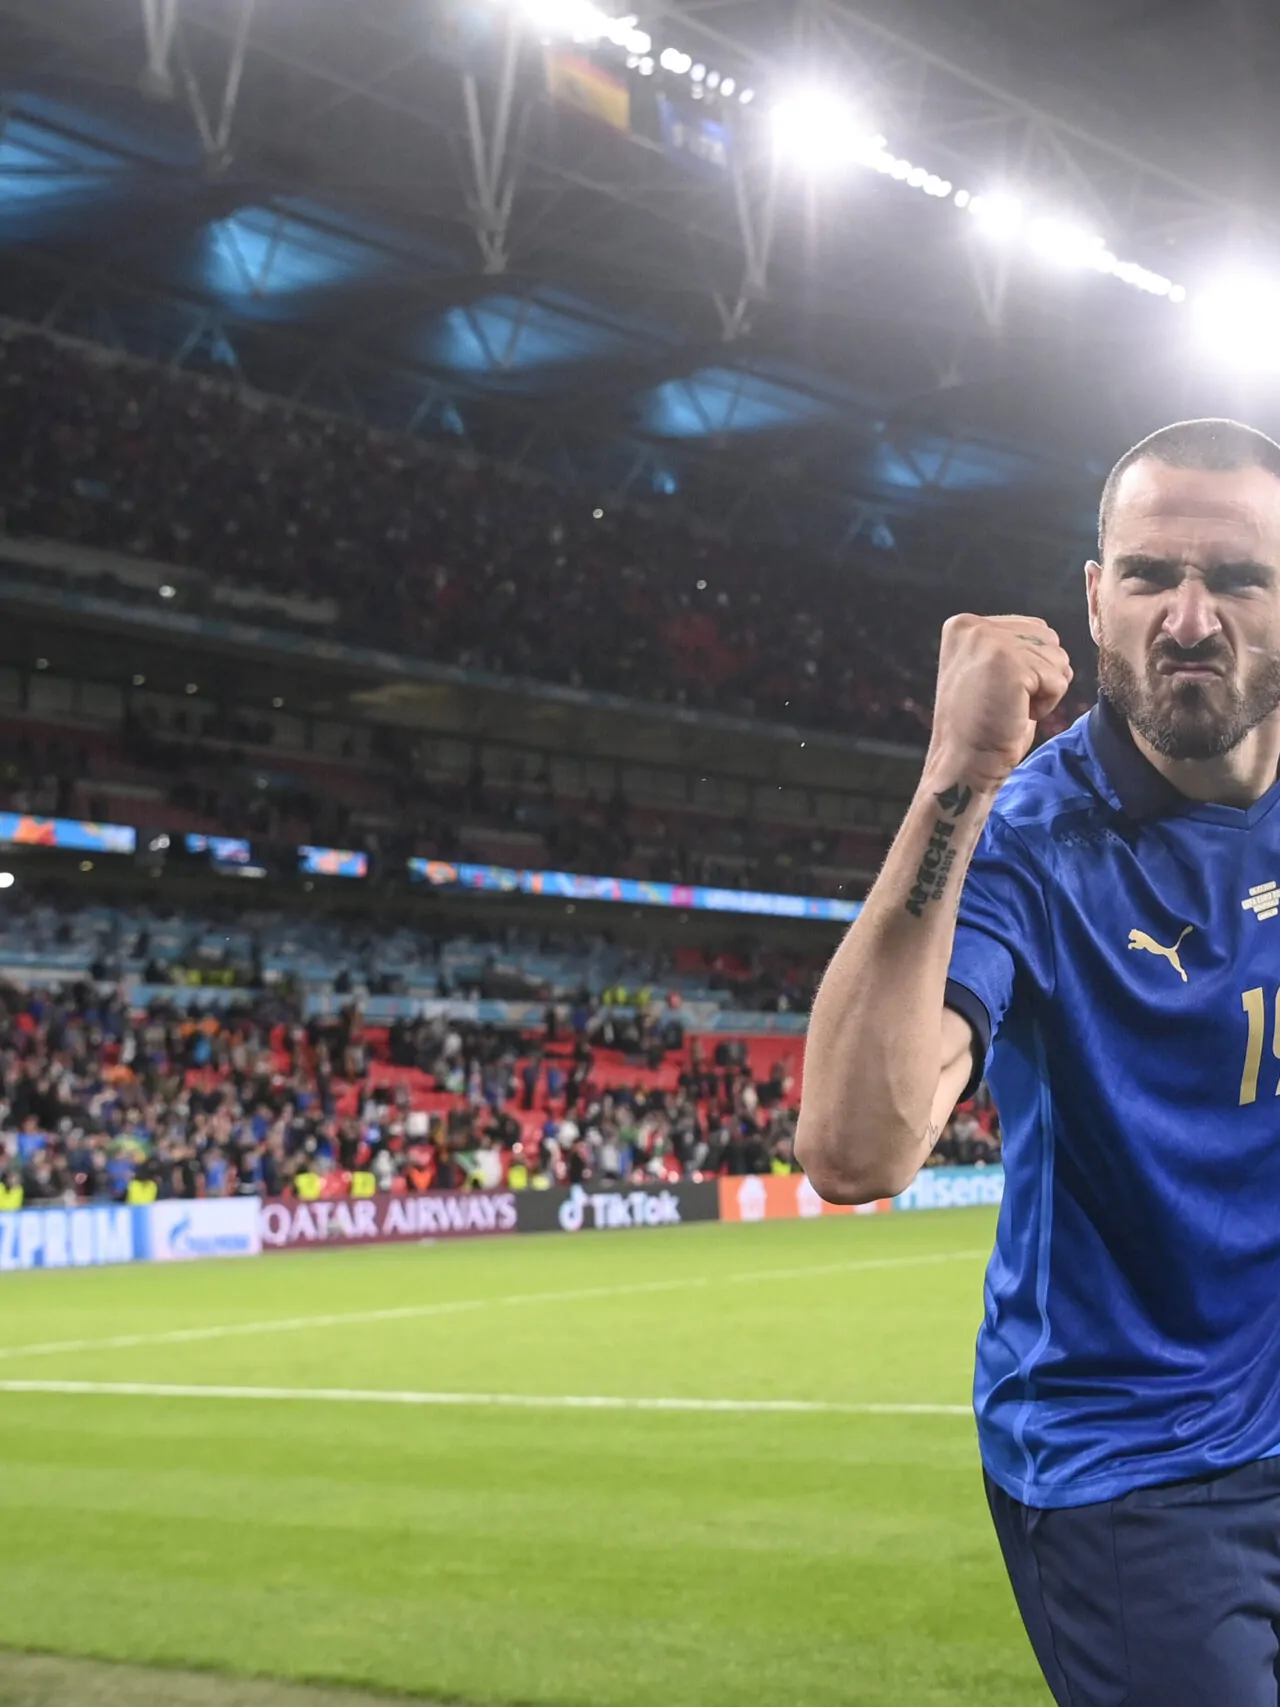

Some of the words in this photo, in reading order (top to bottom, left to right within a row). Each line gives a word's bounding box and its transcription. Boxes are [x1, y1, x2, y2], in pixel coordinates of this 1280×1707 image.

[262, 1202, 378, 1246] QATAR
[383, 1192, 517, 1236] AIRWAYS
[591, 1190, 681, 1229] TikTok
